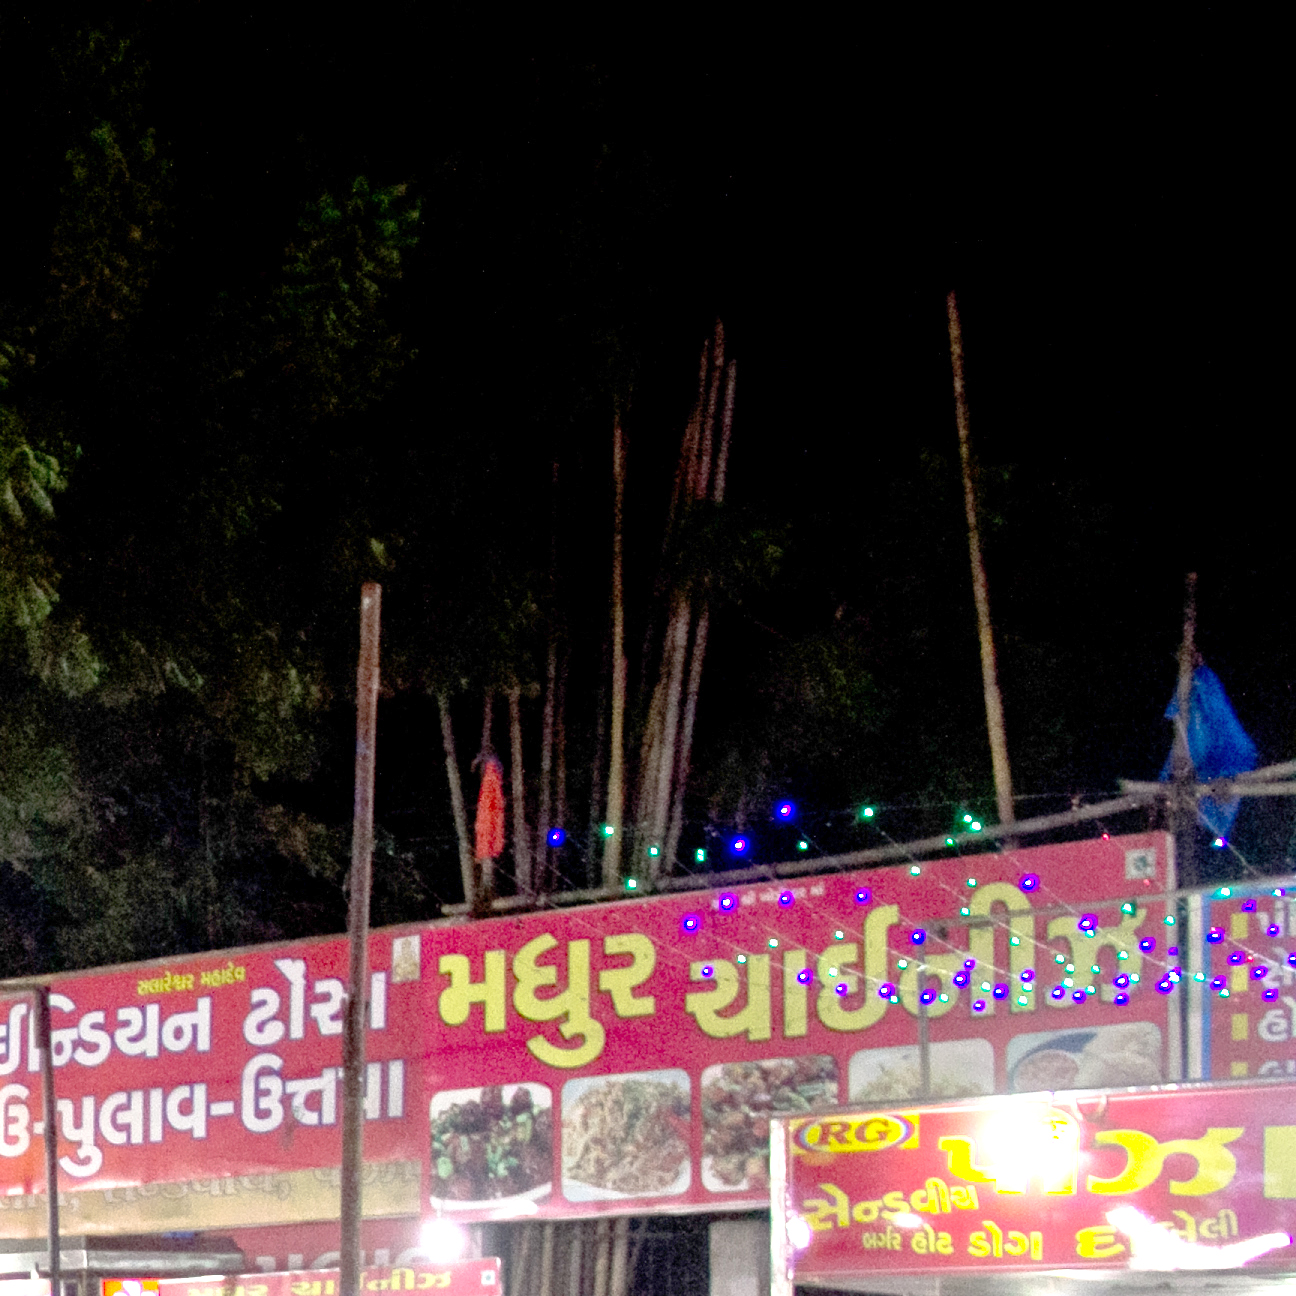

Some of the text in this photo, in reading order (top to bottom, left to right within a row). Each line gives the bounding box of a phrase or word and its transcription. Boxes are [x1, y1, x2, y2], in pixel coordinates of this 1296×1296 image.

[438, 930, 657, 1070] મધુર
[819, 1118, 891, 1147] RG
[802, 1176, 979, 1232] સેન્ડવીચ
[910, 1223, 954, 1256] હોટ
[968, 1220, 1044, 1260] ડોગ
